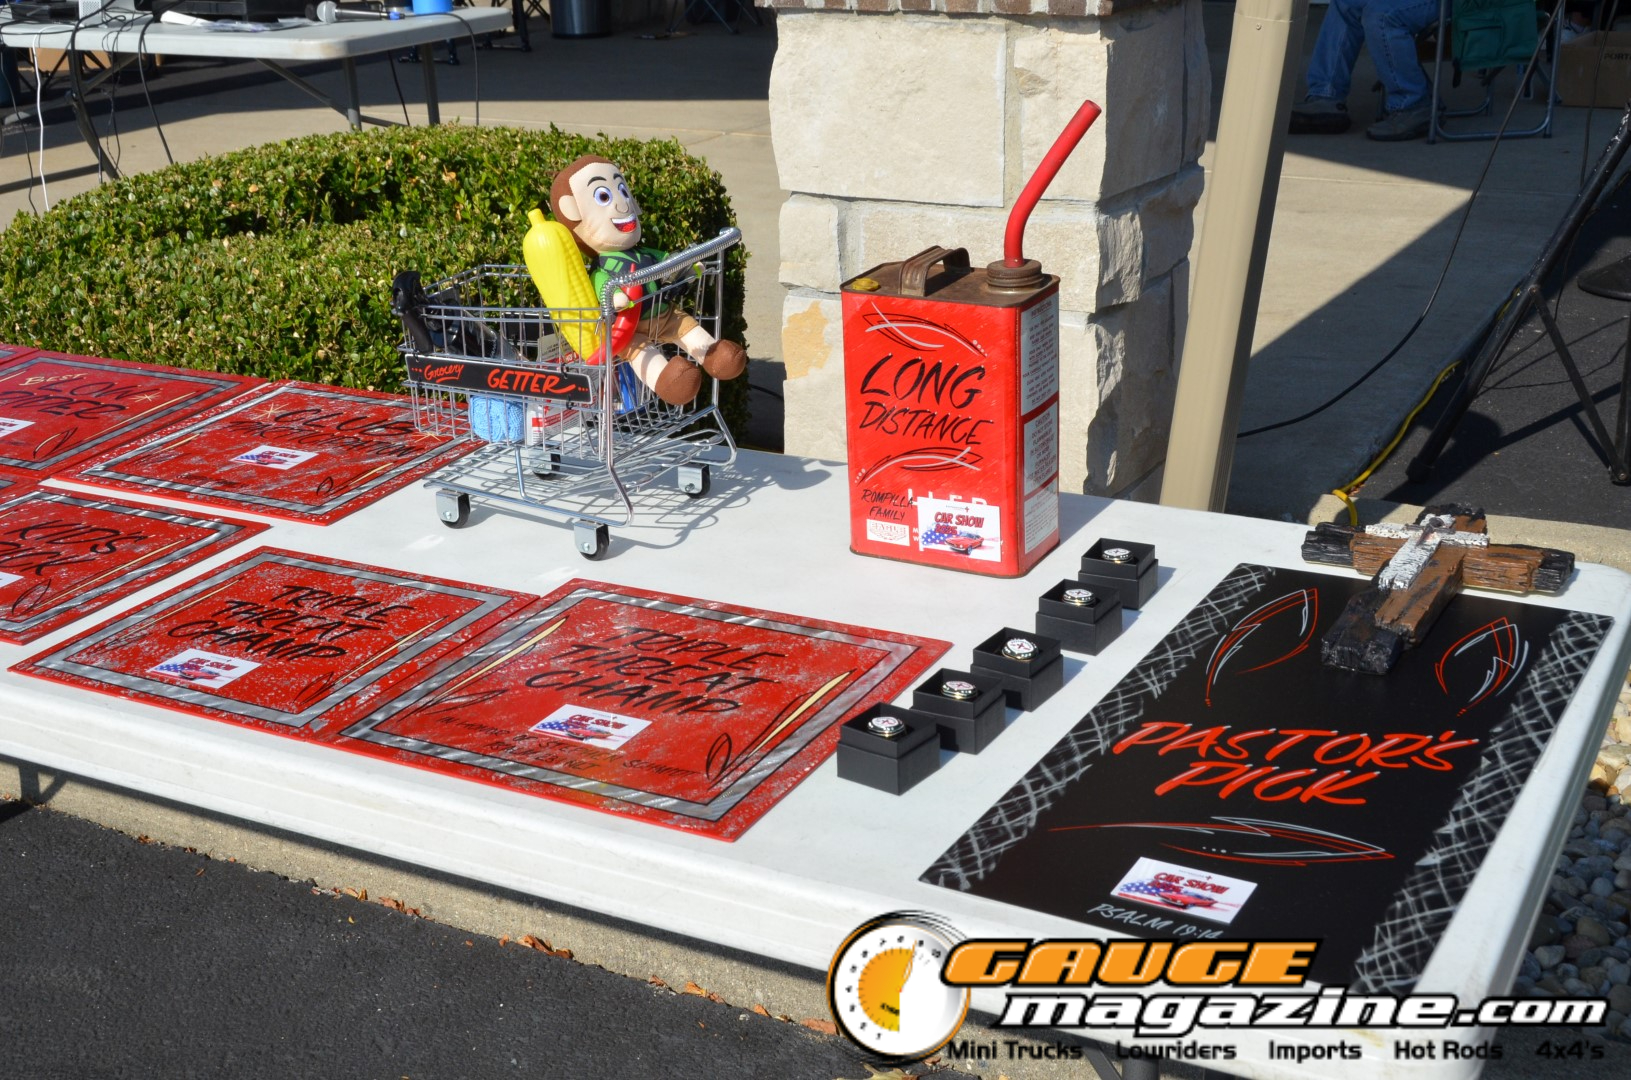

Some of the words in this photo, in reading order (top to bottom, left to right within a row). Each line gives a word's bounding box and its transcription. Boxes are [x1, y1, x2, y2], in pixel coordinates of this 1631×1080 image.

[38, 377, 162, 400] LOW
[424, 364, 464, 380] Grocery
[487, 368, 576, 394] GETTER
[860, 352, 986, 409] LONG
[223, 420, 426, 457] PARTICIPATION
[274, 408, 415, 436] CLUB
[860, 401, 994, 445] DISTANCE
[869, 505, 906, 521] FAMILY
[934, 511, 954, 524] CAR
[955, 514, 985, 528] SHOW
[3, 519, 149, 554] KID'S
[211, 600, 381, 642] THREAT
[270, 585, 415, 624] TRIPLE
[167, 620, 348, 661] CHAMP
[604, 625, 788, 671] TRIPLE
[557, 644, 781, 693] THREAT
[524, 670, 742, 715] CHAMP
[569, 714, 595, 723] CAR
[591, 718, 629, 729] SHOW
[1112, 721, 1480, 771] PASTOR'S
[1154, 761, 1382, 806] PICK
[1153, 871, 1185, 885] CAR
[1182, 878, 1231, 895] SHOW
[1087, 903, 1174, 931] PSALM
[1172, 924, 1224, 940] 19:14
